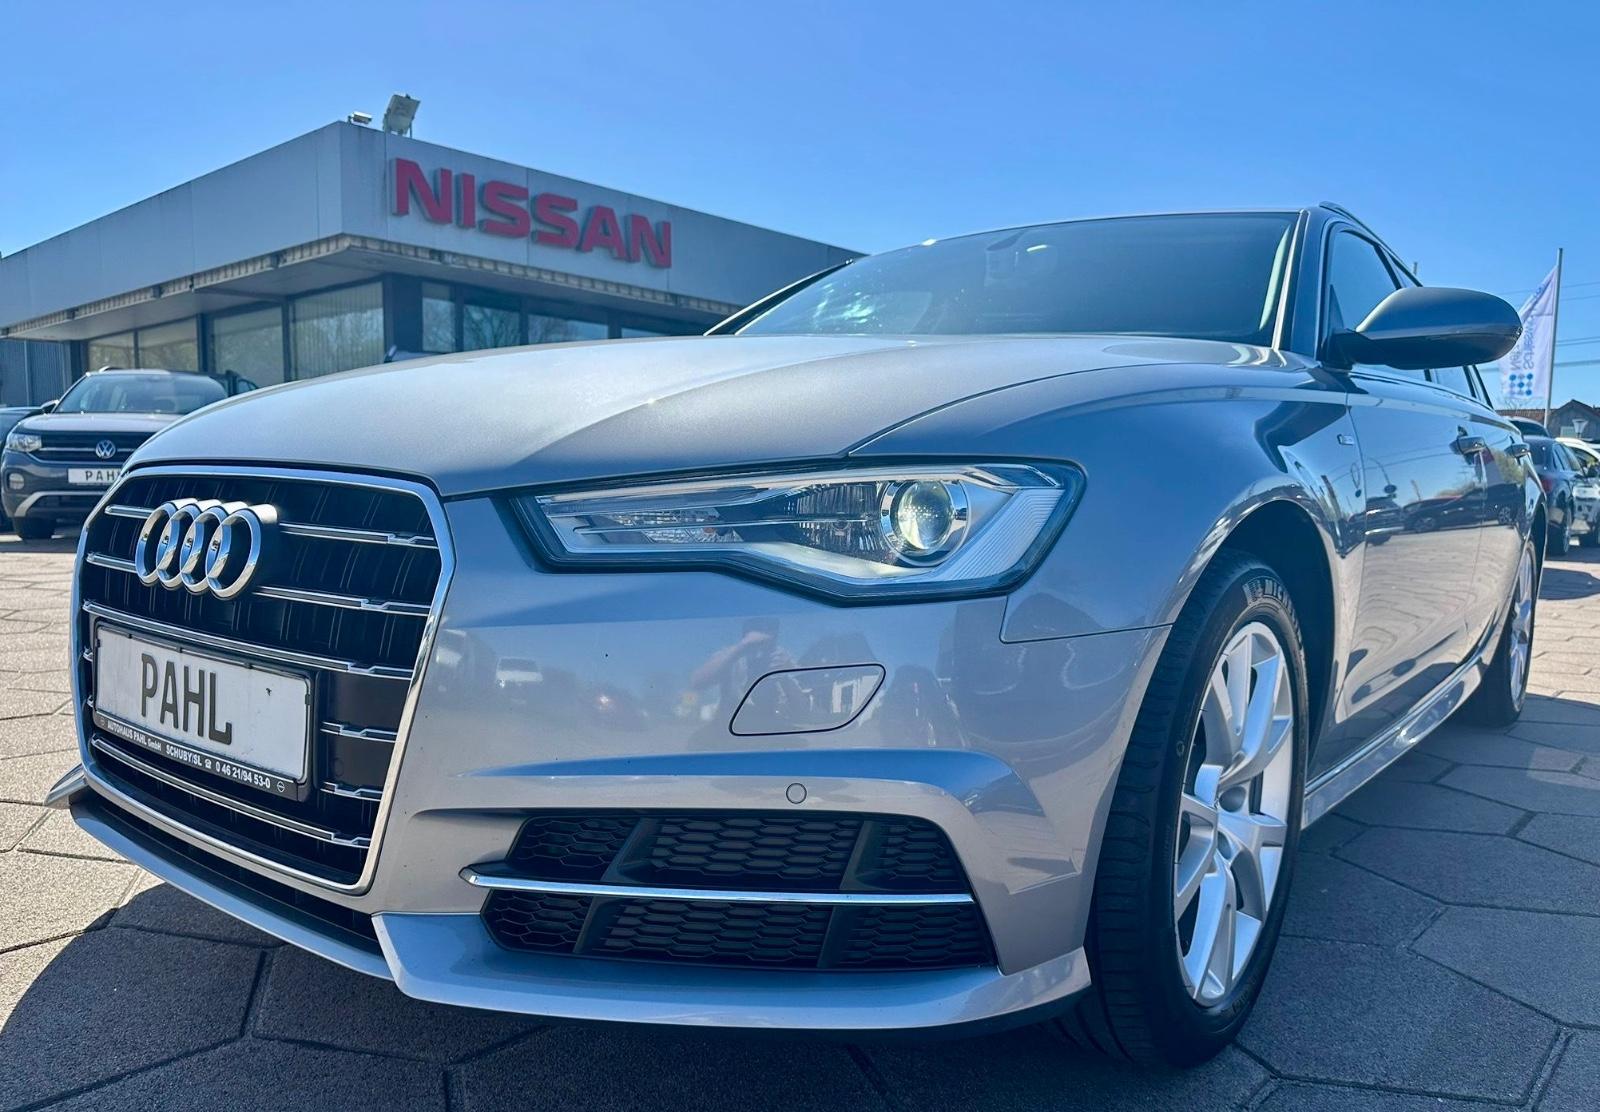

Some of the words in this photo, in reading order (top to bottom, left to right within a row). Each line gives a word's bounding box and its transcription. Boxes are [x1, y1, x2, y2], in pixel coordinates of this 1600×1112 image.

[391, 158, 673, 269] NISSAN
[85, 470, 120, 481] PAH
[140, 652, 233, 746] PAHL
[107, 720, 134, 740] AUTOHAUS
[133, 731, 147, 745] PAHL
[147, 738, 162, 751] GmbH
[166, 744, 203, 767] SCHUBY/SL
[215, 761, 220, 773] 0
[221, 763, 231, 776] 46
[232, 766, 253, 784] 21/94
[253, 773, 271, 789] 53-0
